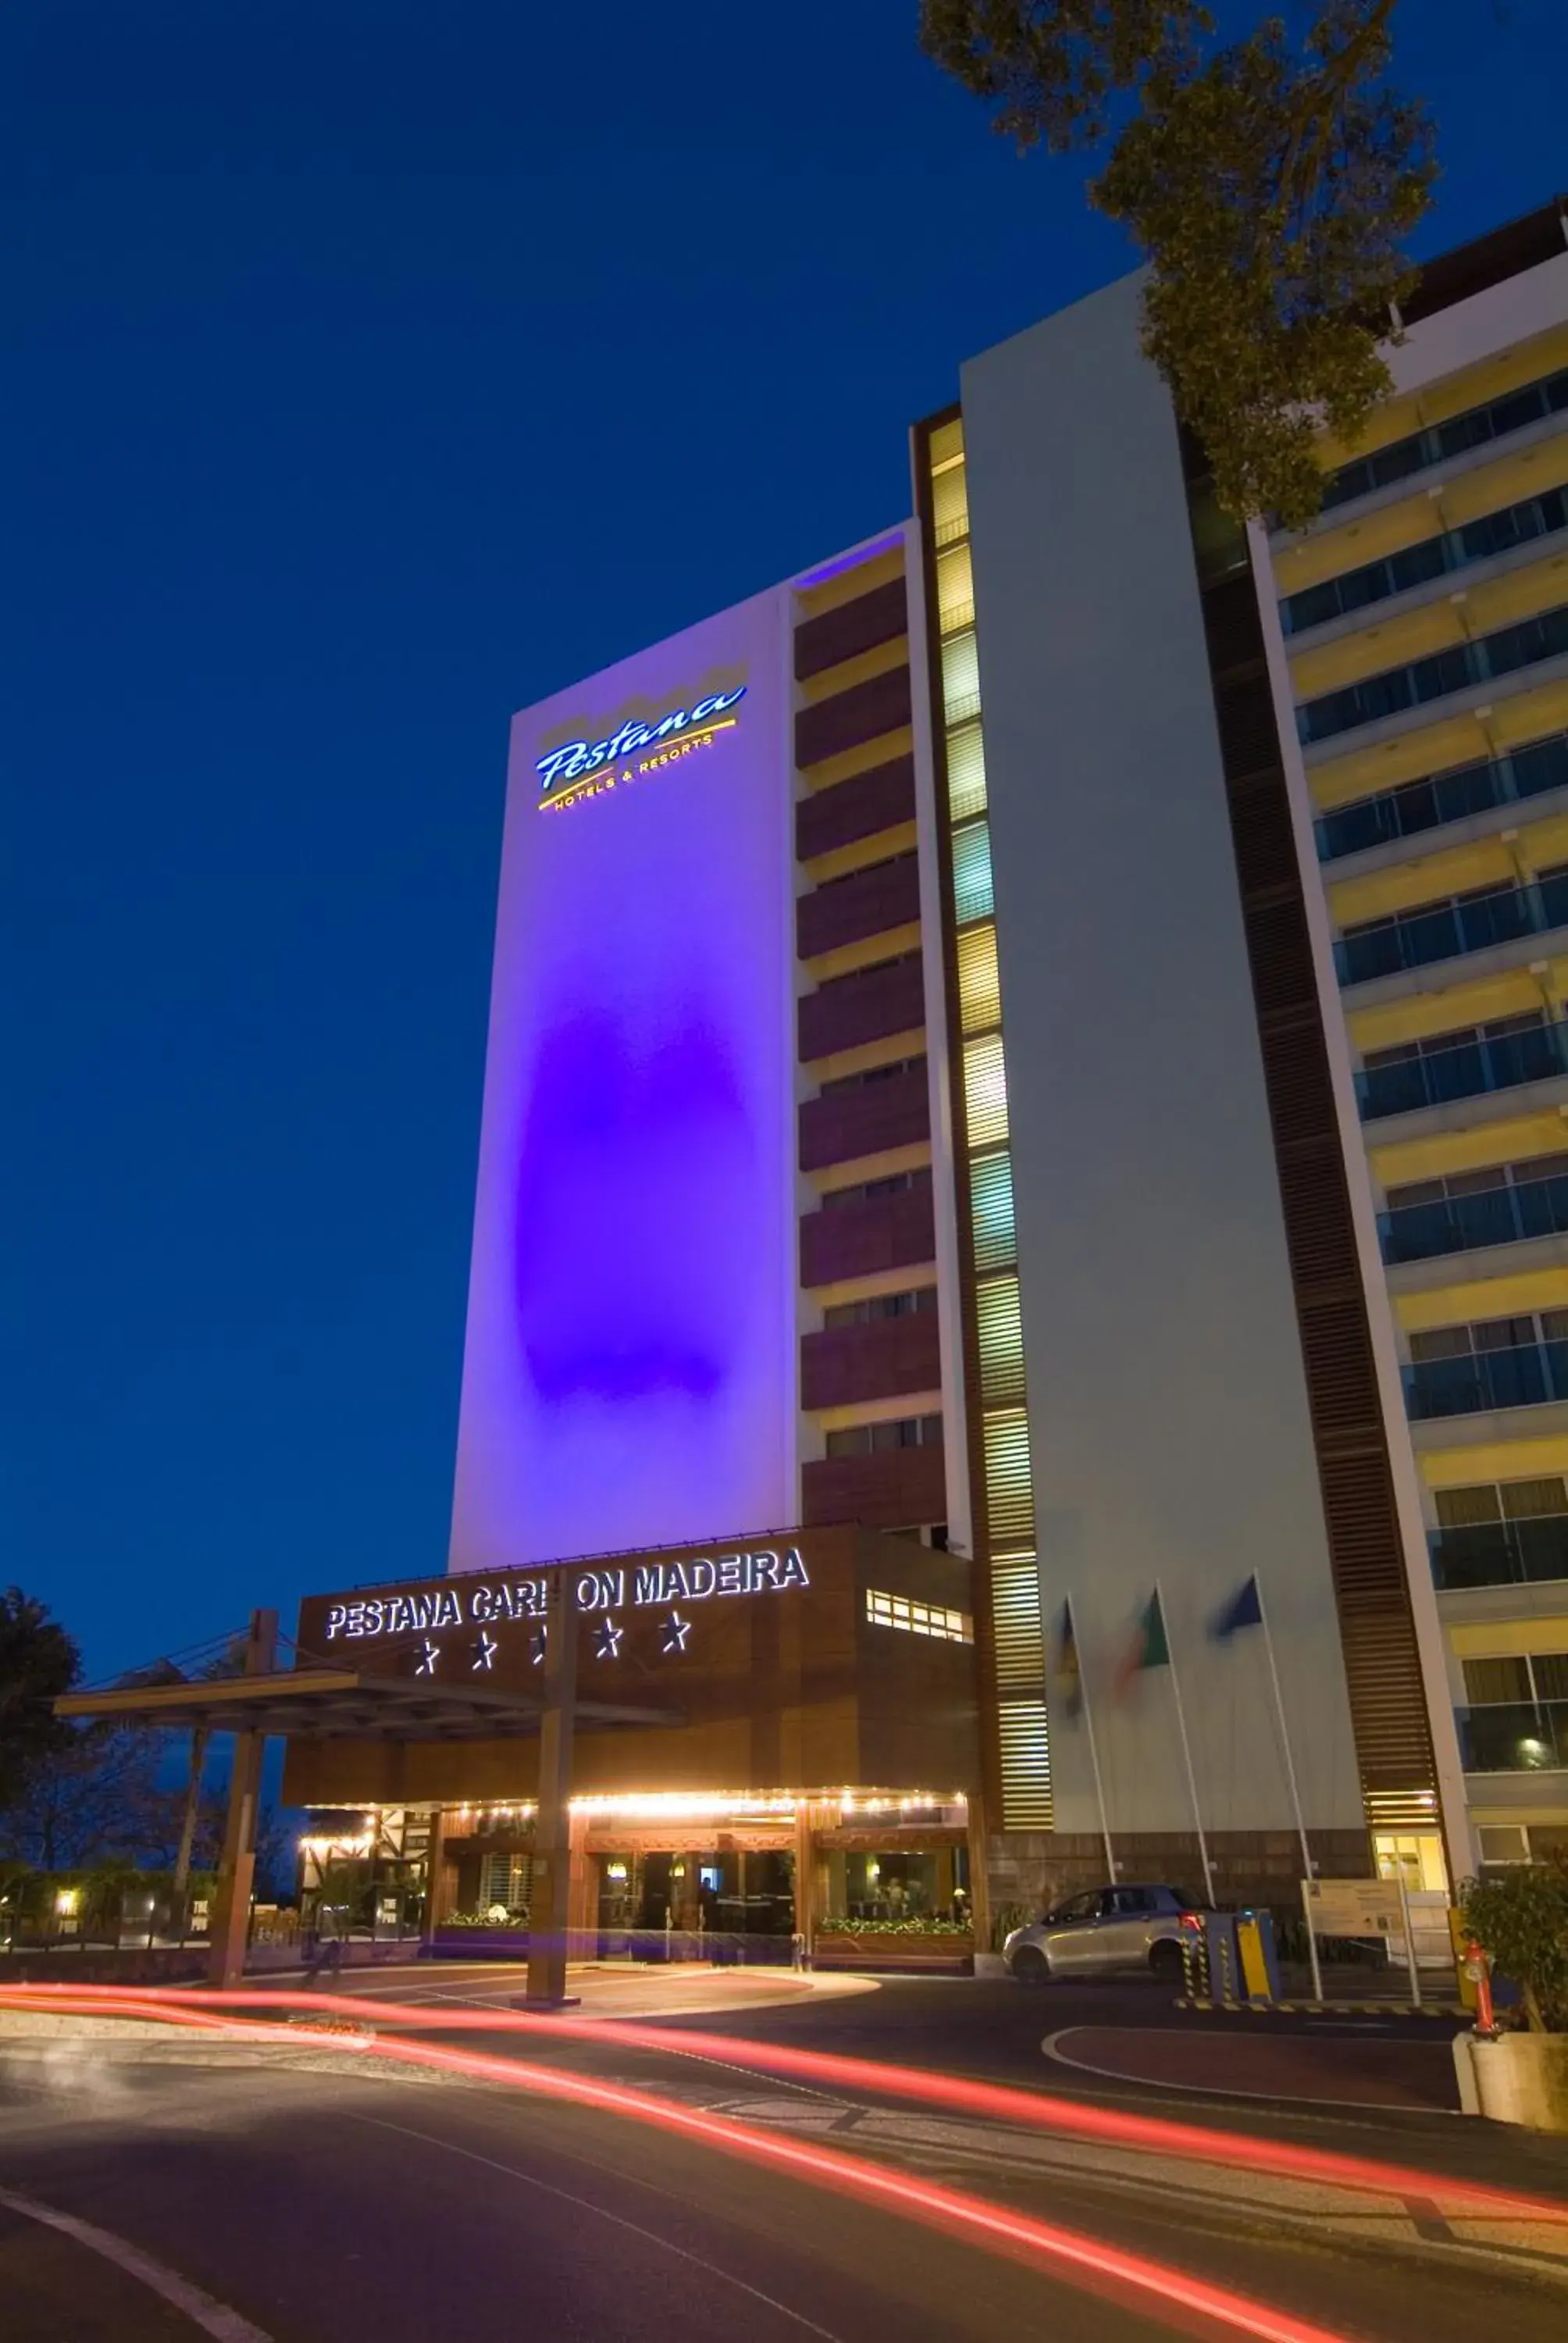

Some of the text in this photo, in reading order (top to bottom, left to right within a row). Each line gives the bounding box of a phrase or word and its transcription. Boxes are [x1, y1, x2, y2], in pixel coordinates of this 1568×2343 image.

[536, 686, 747, 790] Pestana
[554, 734, 712, 811] HOTELS & RESORTS
[326, 1590, 462, 1639] PESTANA
[634, 1547, 810, 1605] MADEIRA
